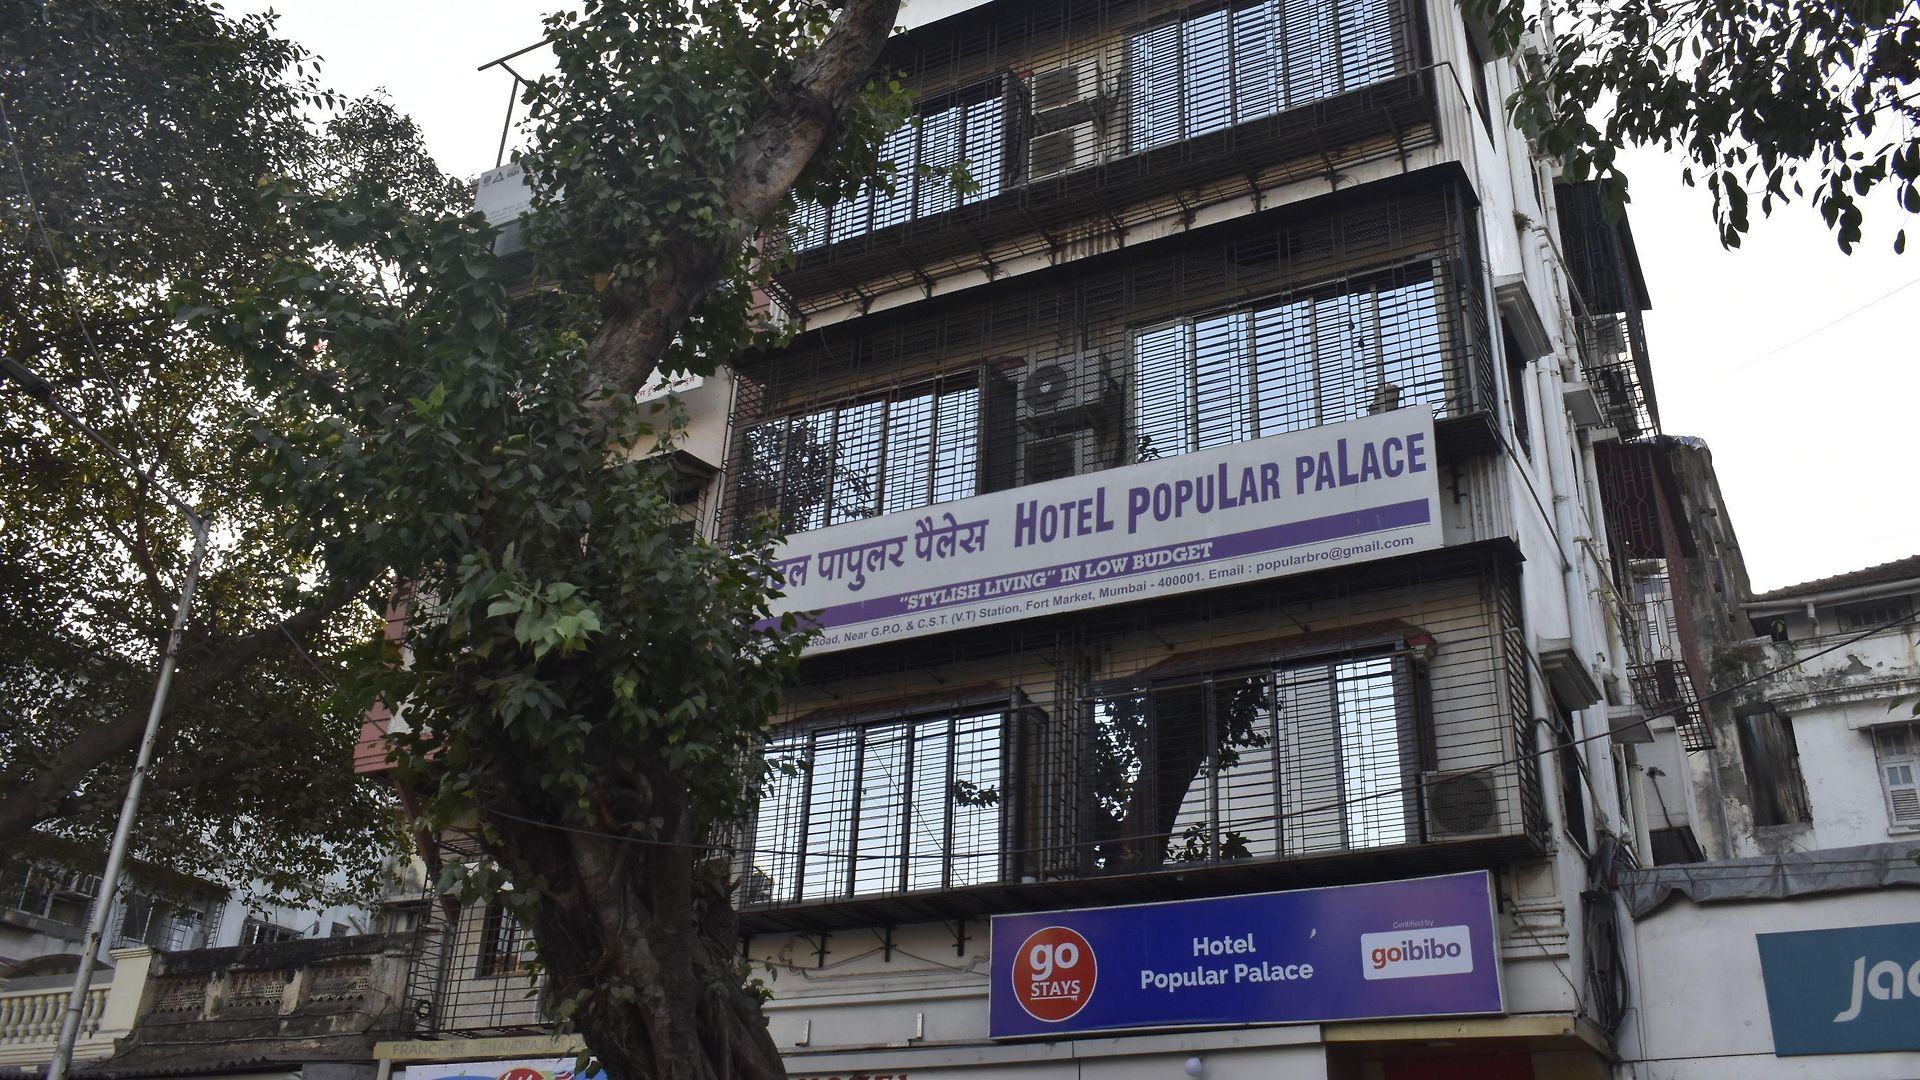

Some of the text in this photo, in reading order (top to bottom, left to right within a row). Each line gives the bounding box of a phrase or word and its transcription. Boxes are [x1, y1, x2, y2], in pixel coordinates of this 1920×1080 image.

[1014, 432, 1427, 548] HOTEL POPULAR PALACE
[817, 535, 908, 592] पापुलर
[915, 512, 990, 562] पैलेस
[1060, 565, 1081, 582] IN
[1085, 556, 1129, 576] LOW
[1132, 542, 1213, 570] BUDGET
[811, 634, 841, 648] Road,
[844, 630, 868, 642] Near
[871, 623, 902, 638] G.P.O.
[906, 621, 914, 631] &
[917, 614, 948, 629] C.S.T.
[951, 610, 976, 625] (V.T)
[979, 603, 1022, 618] Station,
[1026, 599, 1050, 611] Fort
[1052, 591, 1095, 607] Market,
[1099, 580, 1147, 598] Mumbai
[1209, 564, 1244, 580] Email
[1256, 535, 1414, 574] popularbro@gmail.com
[1393, 919, 1434, 929] Certified by
[1030, 942, 1079, 981] go
[1193, 932, 1256, 957] Hotel
[1371, 938, 1462, 970] goibibo
[1031, 980, 1081, 997] STAYS
[1141, 961, 1314, 992] Popular Palace
